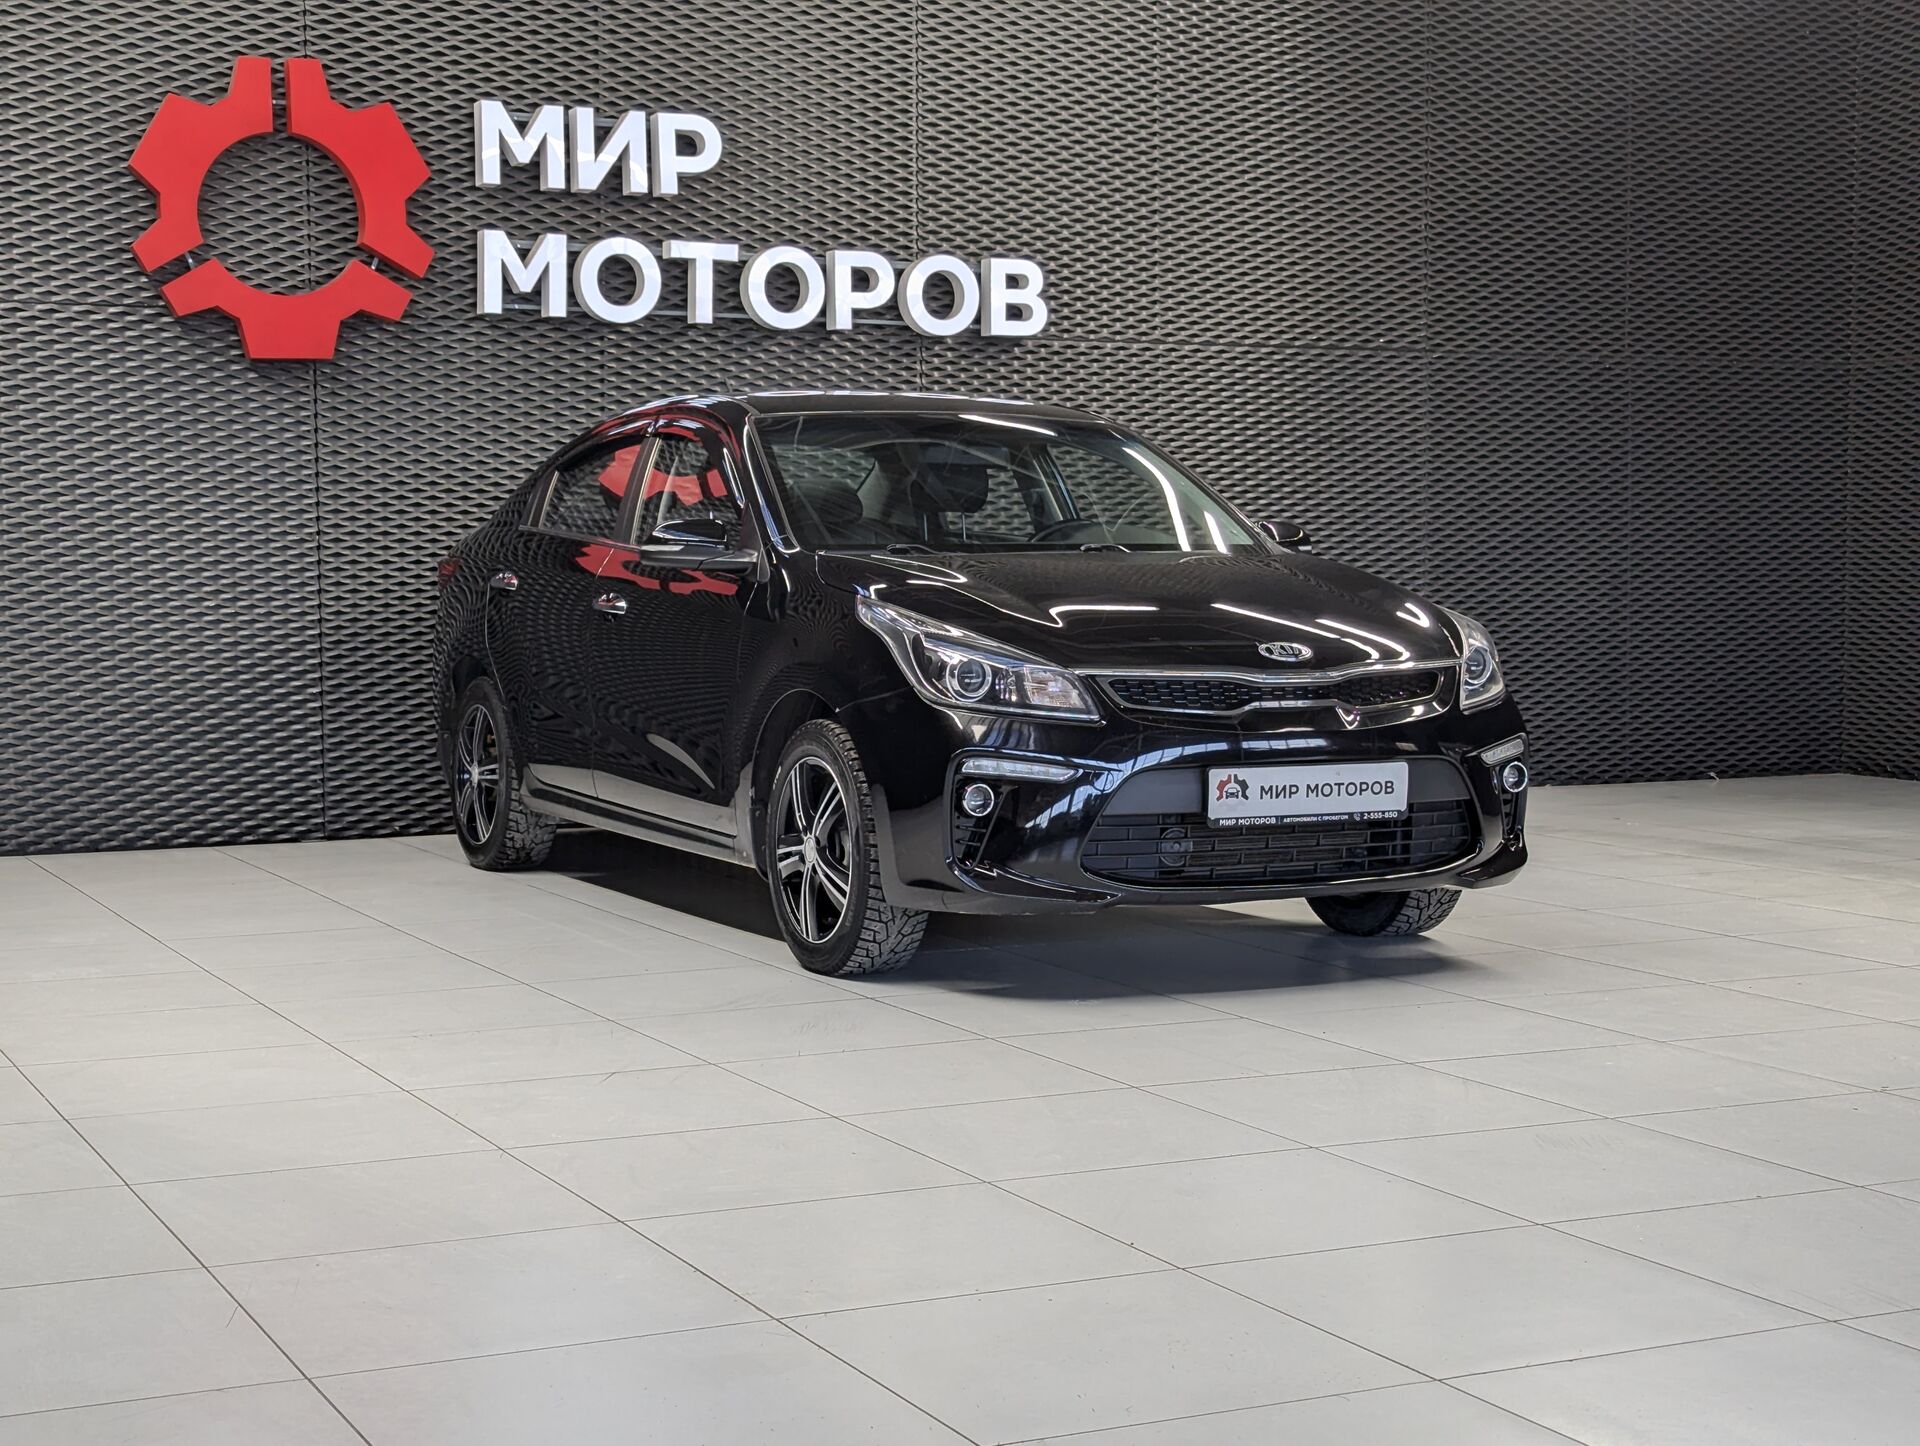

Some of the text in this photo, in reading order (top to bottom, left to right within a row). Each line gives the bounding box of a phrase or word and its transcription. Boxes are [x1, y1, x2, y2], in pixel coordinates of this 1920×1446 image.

[474, 100, 723, 198] МИР
[476, 229, 1049, 338] МОТОРОВ
[1219, 819, 1237, 827] МИР
[1238, 817, 1276, 825] МОТОРОВ
[1363, 811, 1398, 819] 2-555-850
[1259, 780, 1395, 800] МИР МОТОРОВ
